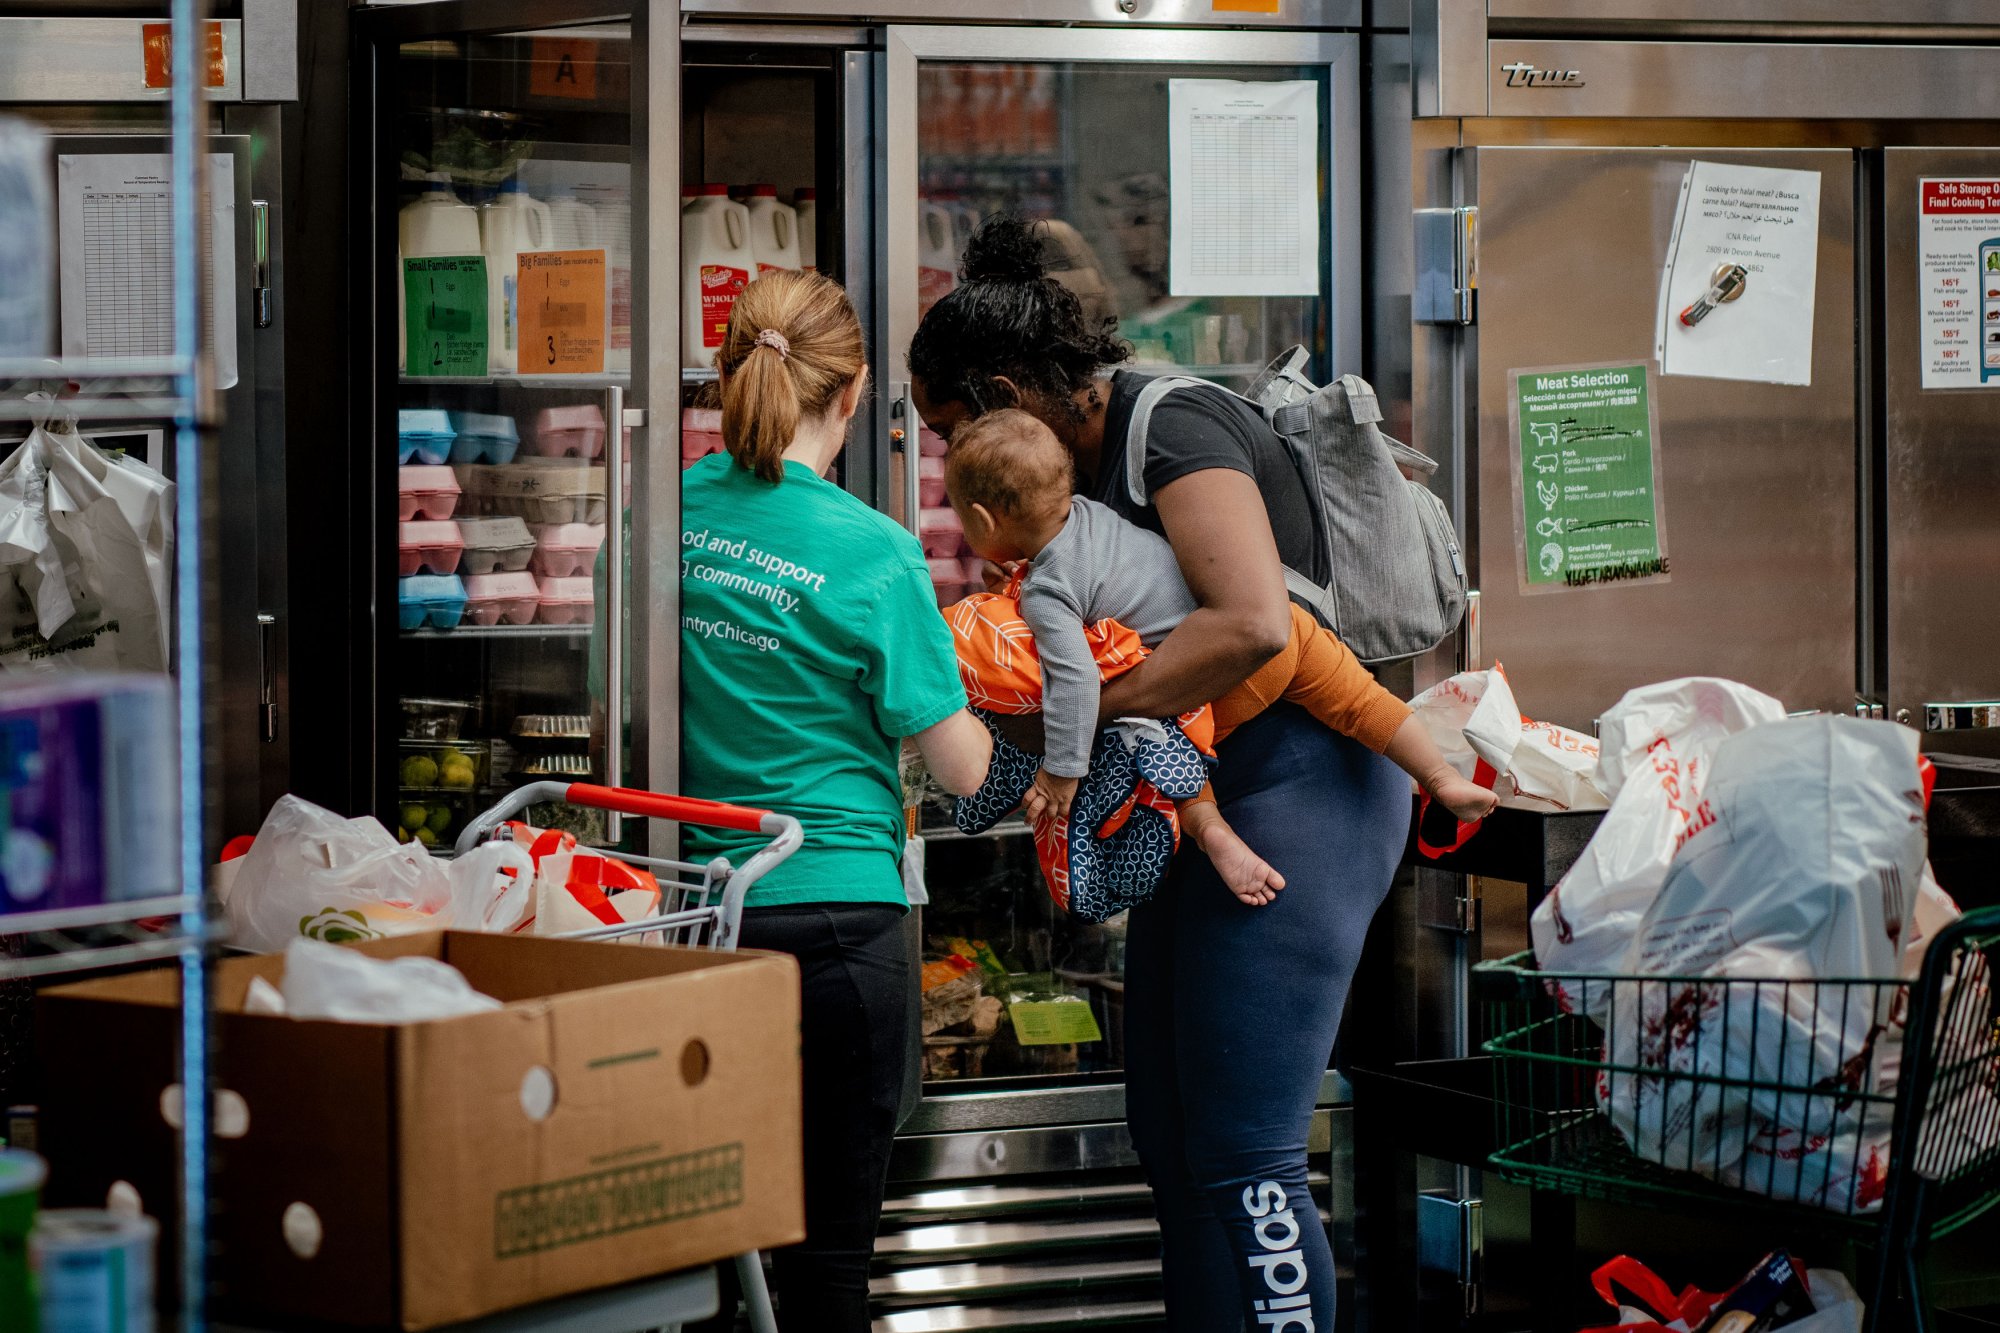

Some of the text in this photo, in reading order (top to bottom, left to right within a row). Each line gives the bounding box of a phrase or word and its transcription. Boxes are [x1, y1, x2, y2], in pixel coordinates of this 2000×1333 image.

[554, 53, 577, 84] A
[1705, 184, 1800, 200] Looking for halal meat? ¿Busca
[1939, 183, 1991, 196] Safe Storage
[1720, 199, 1739, 207] halal?
[1929, 196, 1985, 210] Final Cooking
[1742, 234, 1761, 242] Relief
[1731, 248, 1752, 257] Devon
[1754, 250, 1780, 259] Avenue
[408, 260, 426, 272] Small
[428, 259, 457, 271] Families
[520, 255, 532, 270] Big
[534, 254, 562, 266] Families
[446, 282, 456, 291] Eggs
[560, 279, 569, 287] Eggs
[1942, 279, 1959, 287] 145°F
[1942, 300, 1960, 308] 145°F
[1942, 330, 1960, 338] 155°F
[547, 335, 556, 365] 3
[1942, 350, 1960, 358] 165°F
[1536, 372, 1629, 391] Meat Selection
[1523, 387, 1637, 403] Selección de carnes Wybór mięsa
[1530, 402, 1557, 412] Мясной
[1559, 400, 1605, 411] ассортимент
[1585, 455, 1622, 464] Wieprzowina
[1564, 485, 1588, 493] Chicken
[1591, 543, 1612, 551] Turkey
[708, 536, 748, 560] and
[746, 548, 826, 592] support
[693, 563, 800, 613] community.
[1243, 1181, 1316, 1333] didas
